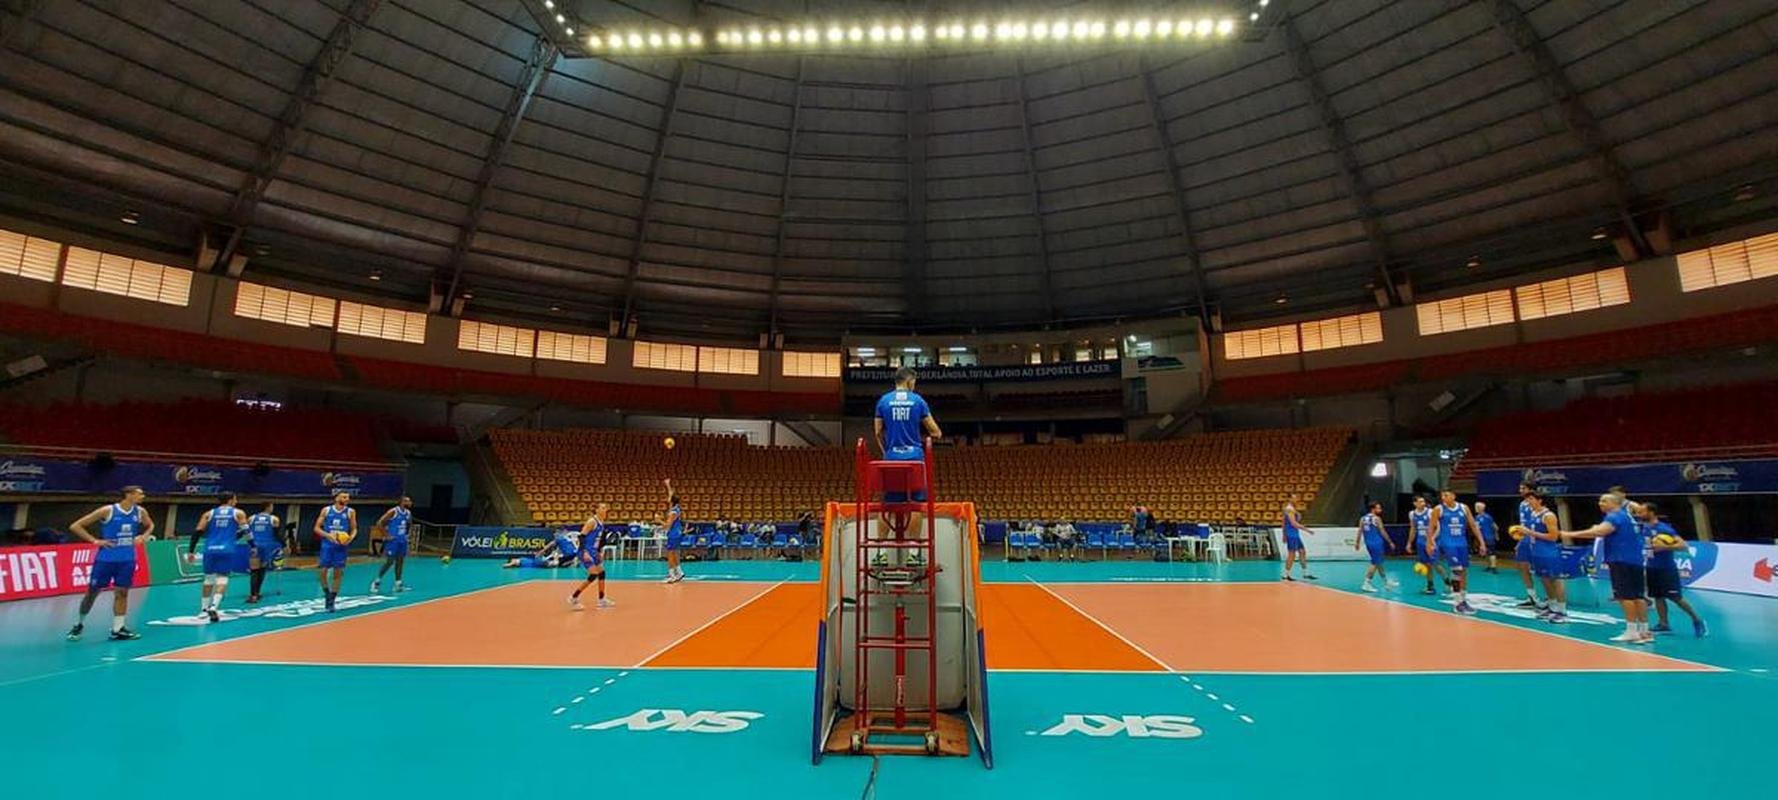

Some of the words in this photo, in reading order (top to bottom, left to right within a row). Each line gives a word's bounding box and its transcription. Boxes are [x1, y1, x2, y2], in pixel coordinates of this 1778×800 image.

[851, 370, 898, 380] PREFEITUR
[892, 407, 911, 421] FIAT
[0, 551, 58, 593] FIAT
[1040, 714, 1204, 739] SKY
